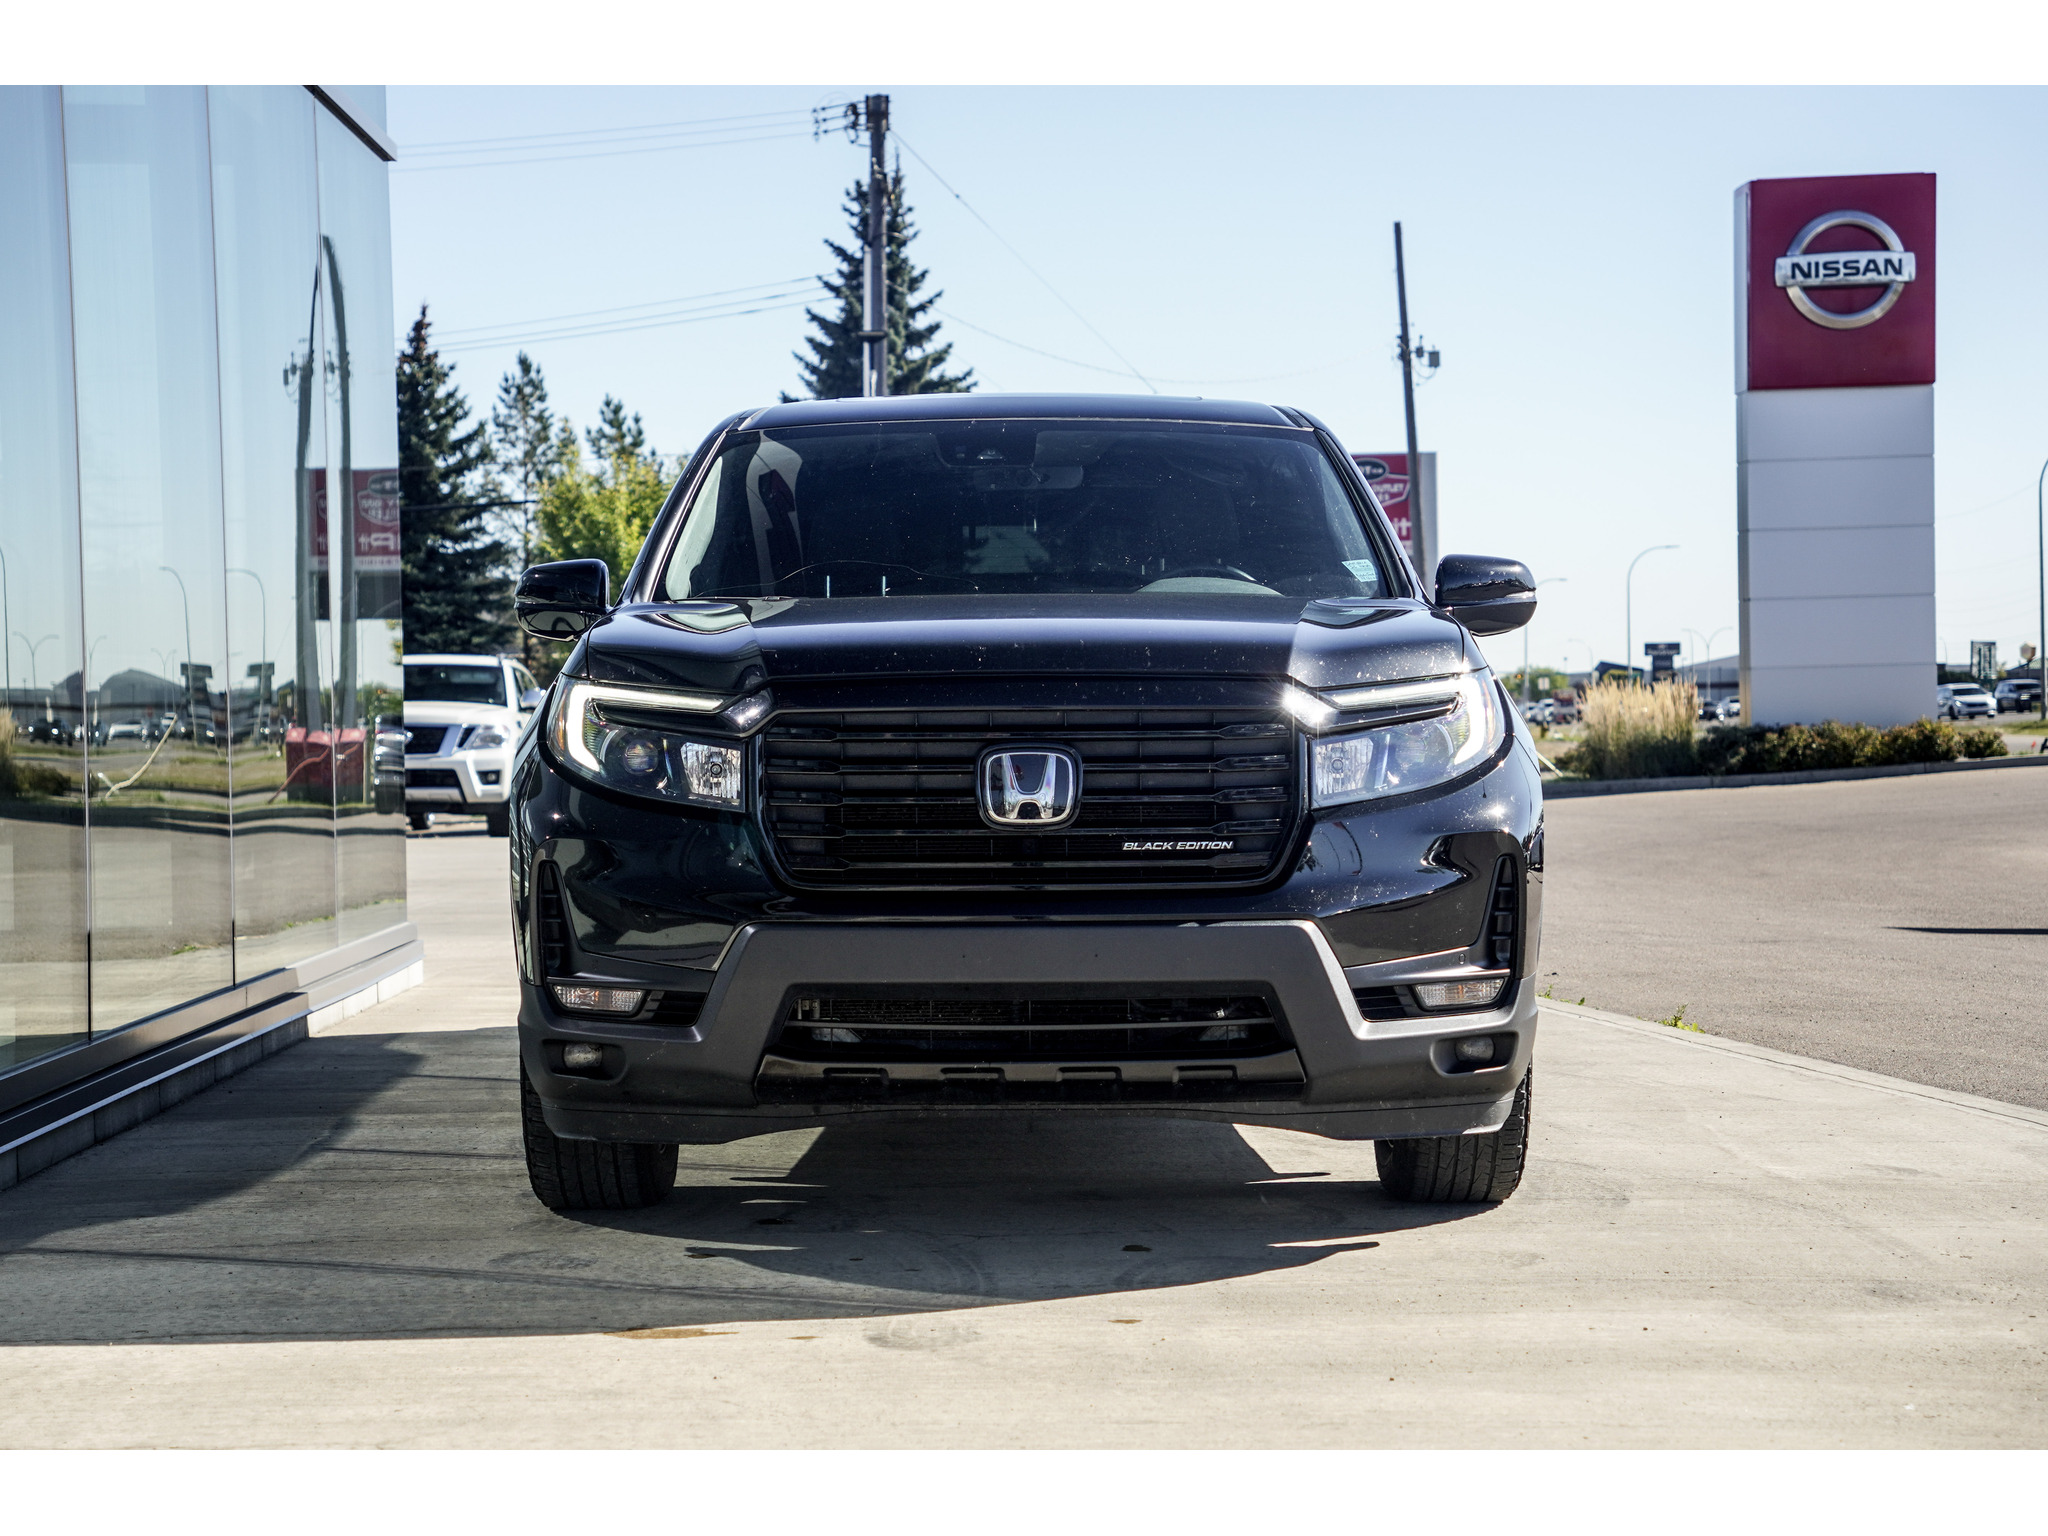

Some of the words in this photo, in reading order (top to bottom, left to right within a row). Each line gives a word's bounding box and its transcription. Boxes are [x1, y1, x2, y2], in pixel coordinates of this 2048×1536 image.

[1790, 258, 1903, 279] NISSAN
[1122, 841, 1174, 851] BLACK
[1176, 840, 1234, 850] EDITION
